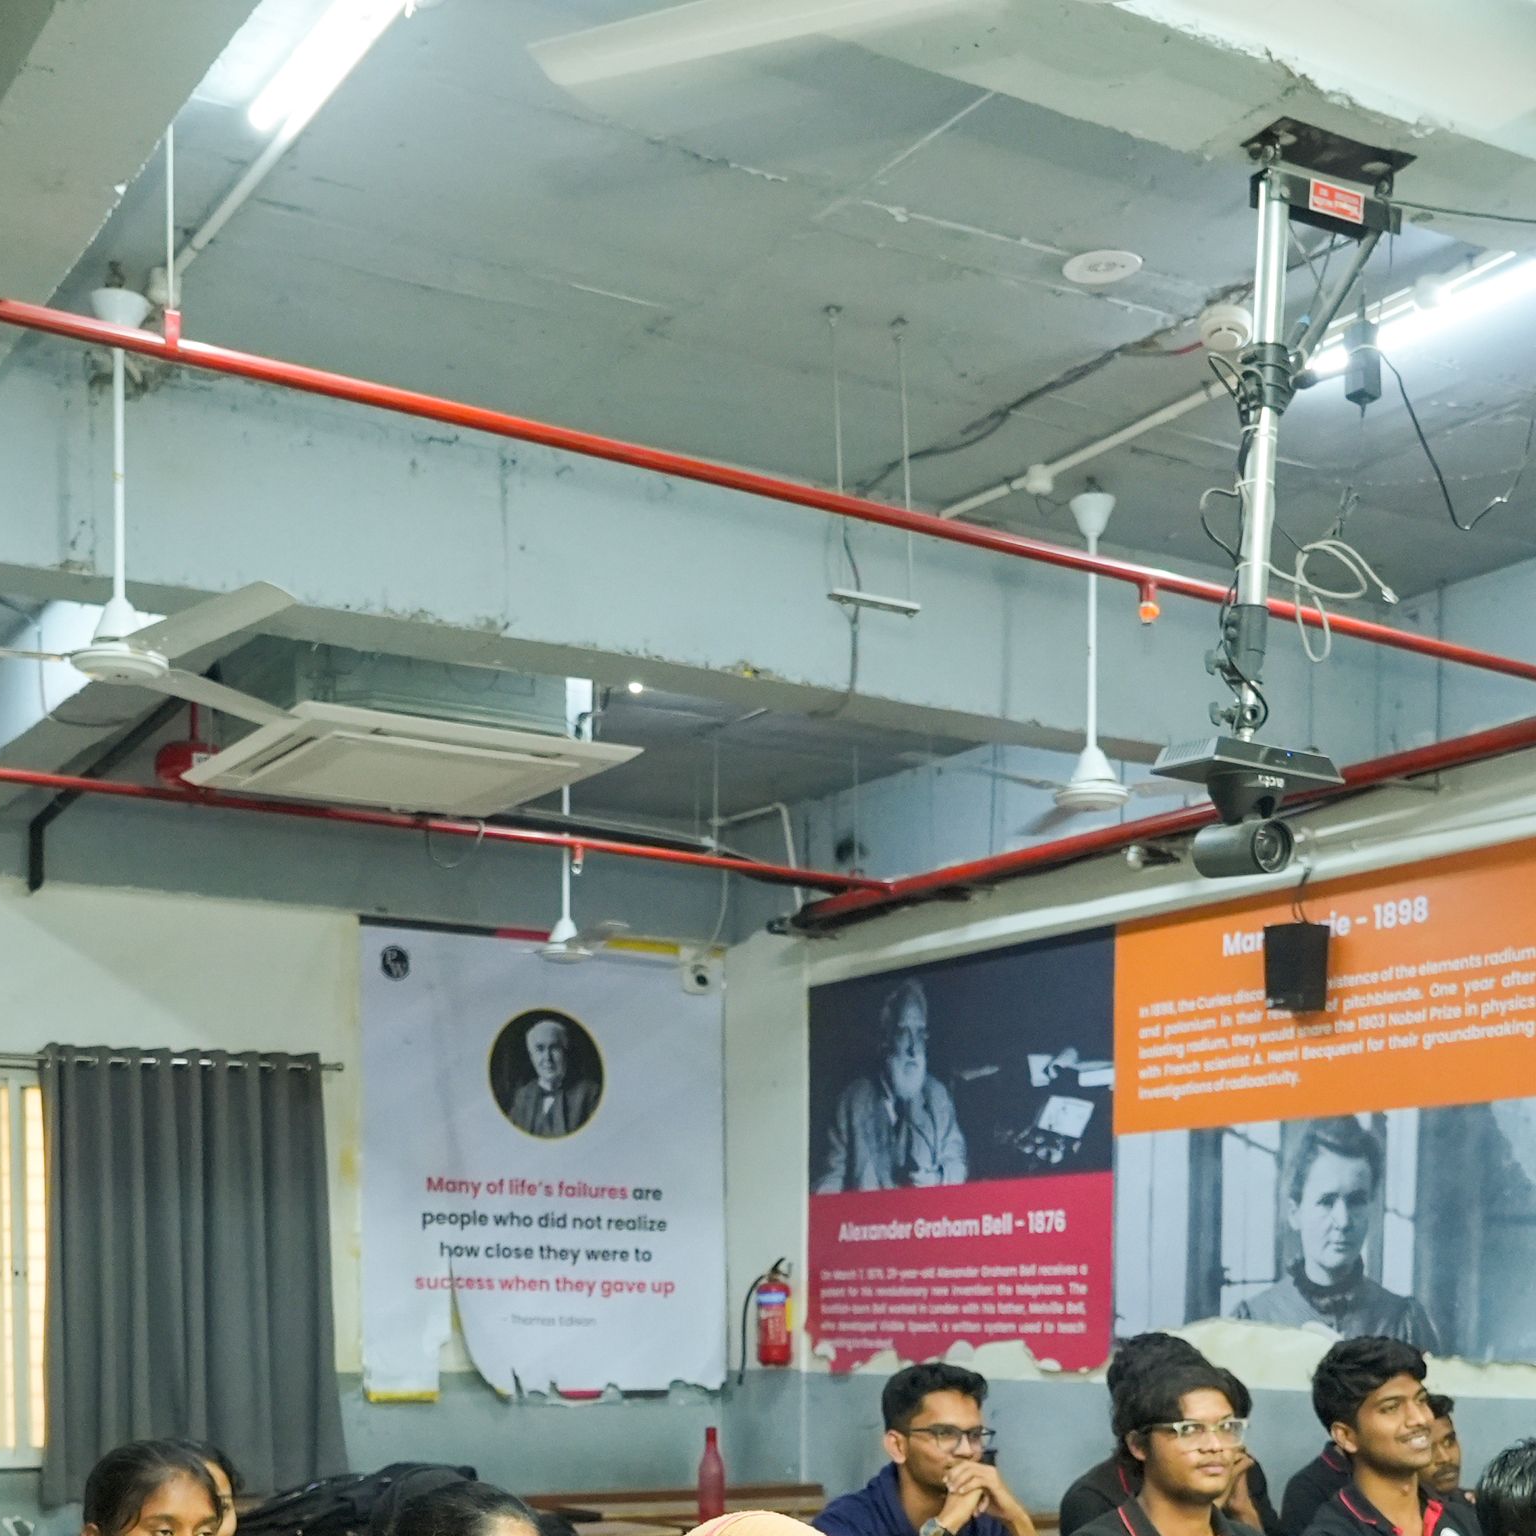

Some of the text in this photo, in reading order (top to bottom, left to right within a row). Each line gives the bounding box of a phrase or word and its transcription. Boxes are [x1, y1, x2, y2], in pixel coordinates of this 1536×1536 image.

[1373, 895, 1429, 930] 1898
[1380, 966, 1394, 982] of
[1395, 965, 1416, 979] the
[1418, 955, 1482, 976] elements
[1484, 947, 1536, 966] radium
[1139, 1024, 1161, 1039] and
[1163, 1018, 1217, 1038] polonium
[1220, 1013, 1232, 1027] in
[1235, 1009, 1263, 1025] their
[1343, 987, 1423, 1014] pitchblende.
[1429, 982, 1458, 998] One
[1463, 976, 1495, 998] year
[1501, 970, 1536, 988] after
[1139, 1043, 1185, 1060] isolating
[1186, 1036, 1229, 1052] radium,
[1231, 1033, 1257, 1049] they
[1259, 1026, 1296, 1043] would
[1296, 1022, 1333, 1038] share
[1334, 1018, 1356, 1034] the
[1388, 1007, 1427, 1026] Nobel
[1429, 1003, 1462, 1021] Prize
[1464, 1000, 1478, 1017] in
[1480, 994, 1536, 1019] physics
[426, 1176, 482, 1199] Many
[486, 1178, 504, 1195] of
[558, 1180, 628, 1200] failures
[632, 1187, 663, 1201] are
[422, 1210, 667, 1232] people who did not realize
[838, 1219, 913, 1243] Alexander
[913, 1215, 981, 1240] Graham
[981, 1212, 1014, 1237] Bell
[1027, 1208, 1067, 1234] 1876
[439, 1241, 652, 1267] how close they were to
[415, 1276, 676, 1299] success when they gave up
